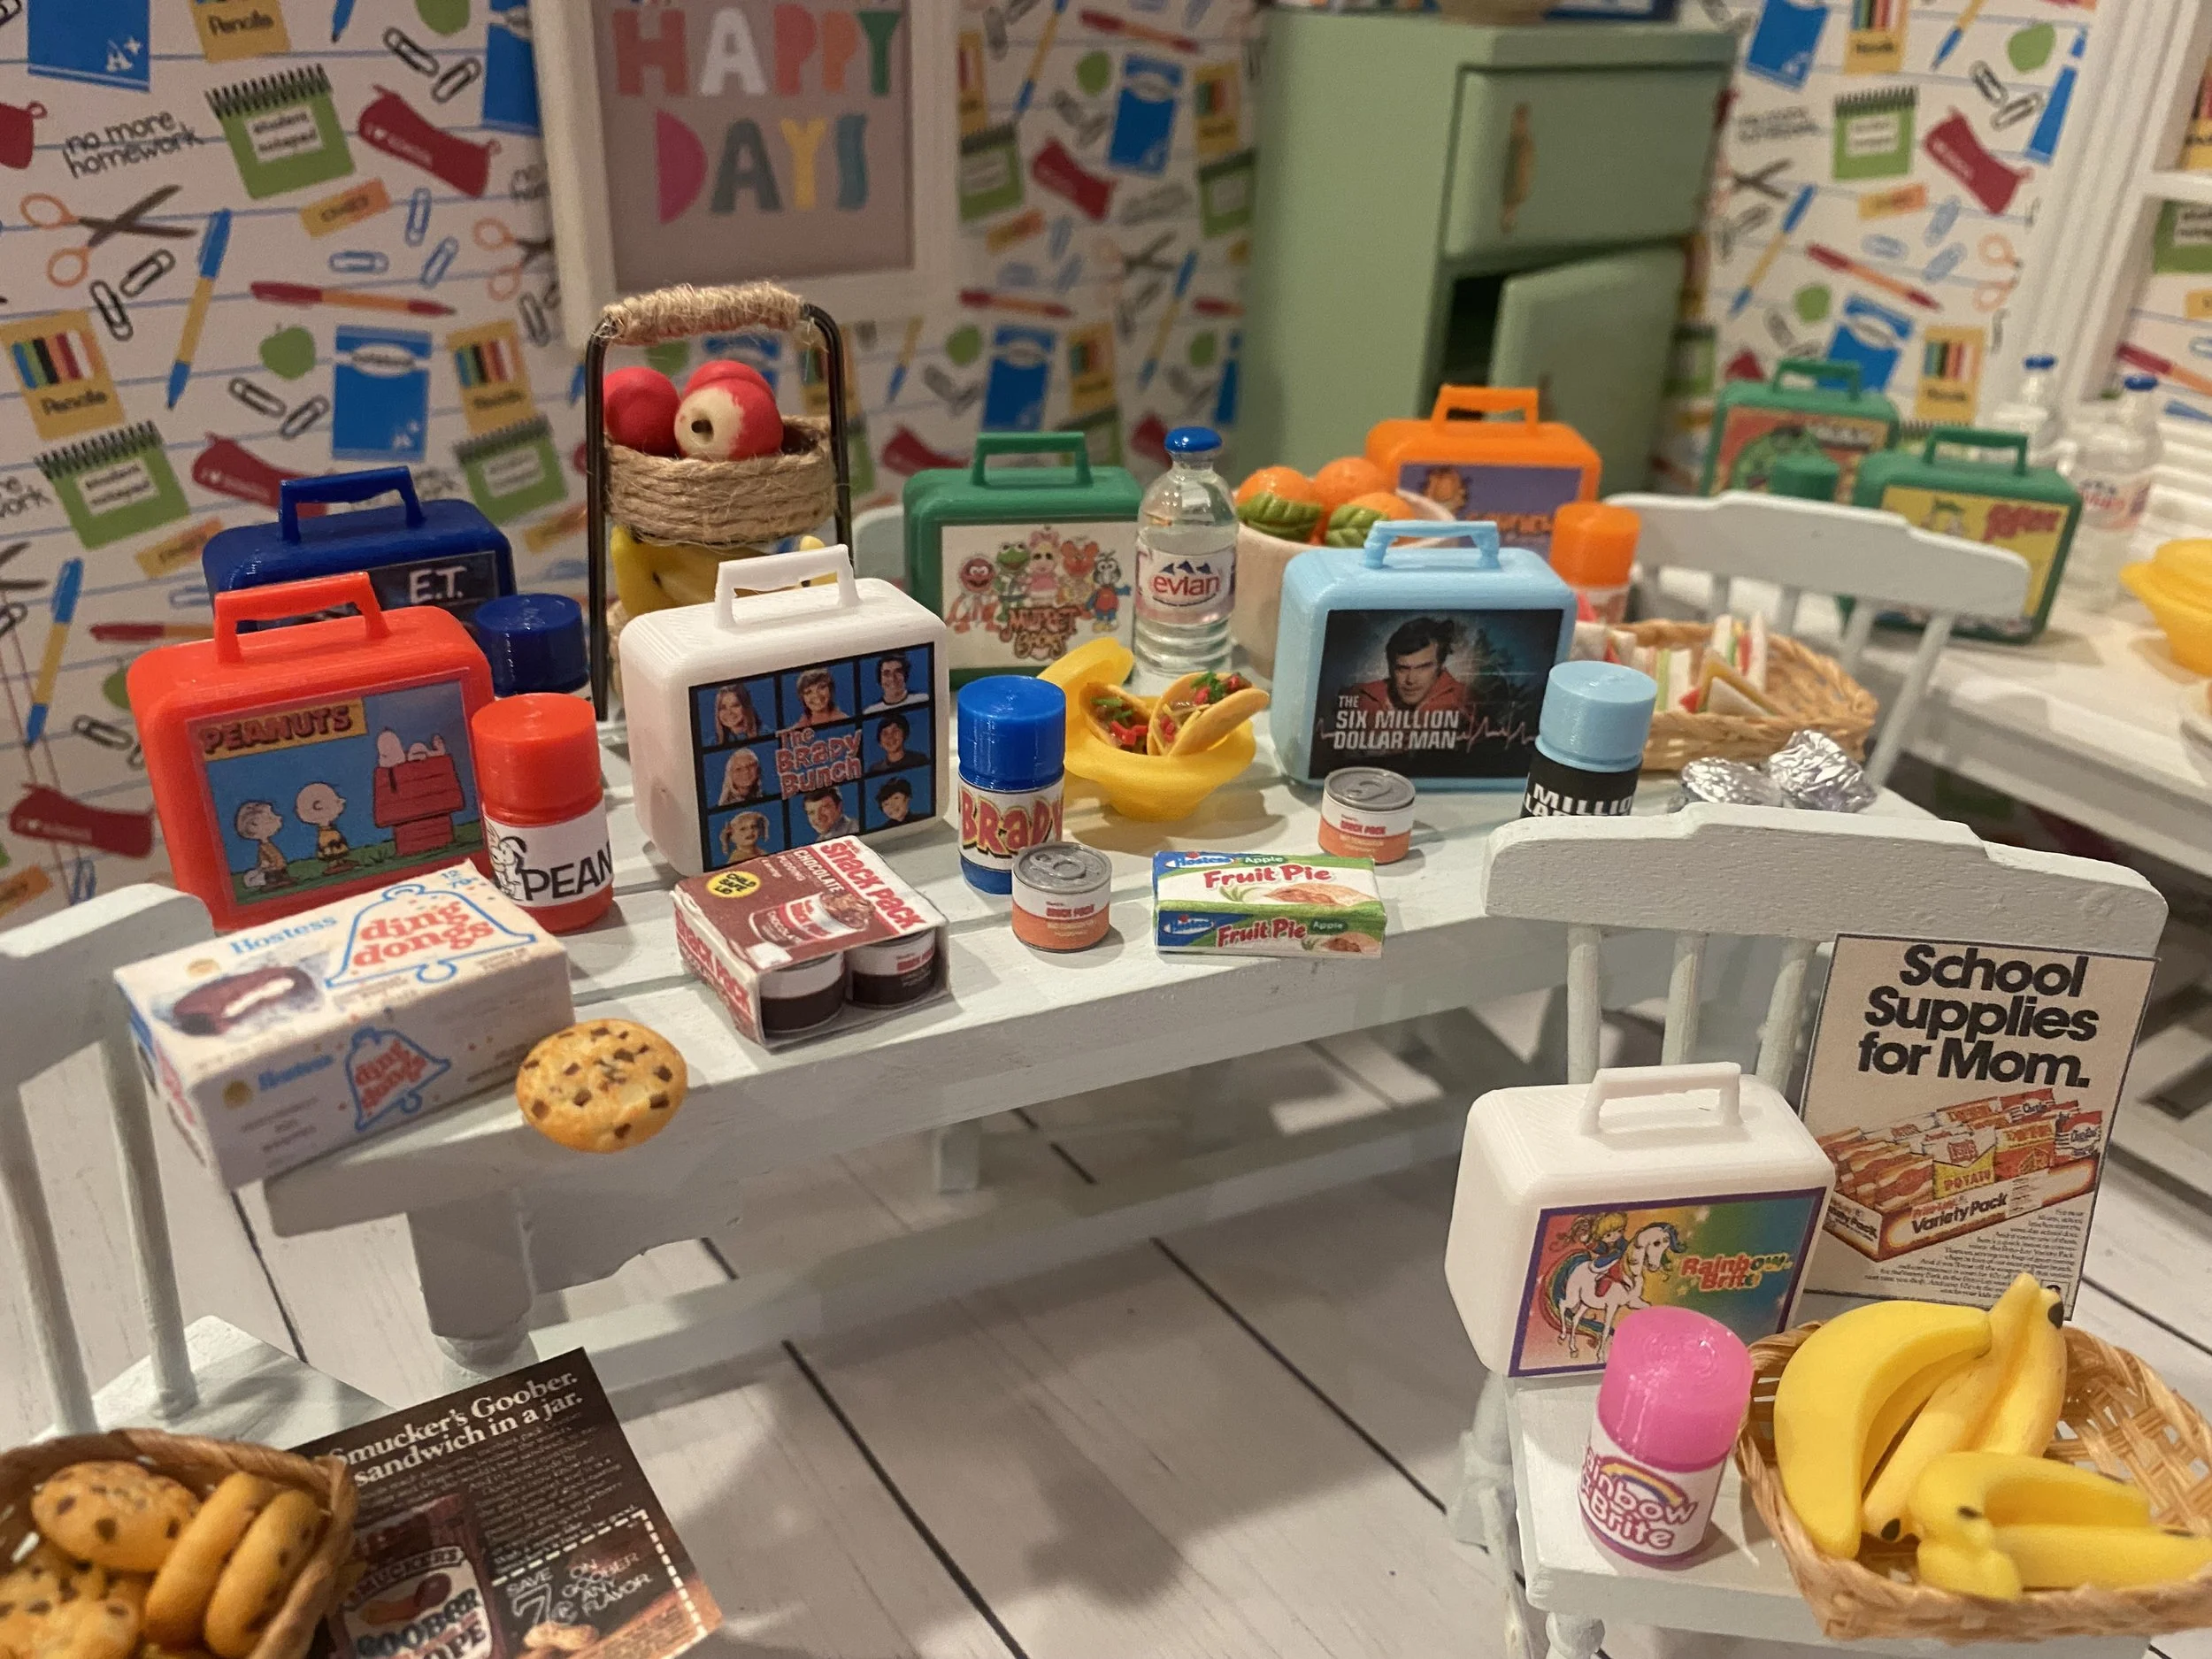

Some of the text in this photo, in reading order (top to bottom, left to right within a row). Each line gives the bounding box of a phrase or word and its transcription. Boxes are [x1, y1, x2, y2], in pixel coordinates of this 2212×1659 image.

[613, 4, 901, 97] HAPPY
[63, 121, 204, 179] homework
[65, 110, 177, 153] no more
[410, 566, 467, 603] E.T.
[1154, 576, 1220, 595] evian
[1335, 710, 1460, 729] SIX MILLION
[1339, 695, 1359, 708] THE
[200, 705, 352, 754] PEANUTS
[1333, 730, 1456, 749] DOLLAR MAN
[790, 849, 846, 893] CHOCOLATE
[1203, 864, 1333, 888] Fruit Pie
[1244, 856, 1284, 864] Apple
[230, 915, 338, 956] Hostess
[360, 900, 471, 943] ding
[1217, 917, 1343, 949] Fruit Pie Apple
[351, 921, 495, 968] dongs
[1899, 943, 2089, 997] School
[1864, 985, 2099, 1043] Supplies
[1857, 1031, 2091, 1088] for Mom.
[1911, 1200, 1970, 1234] Variety
[1969, 1192, 2008, 1217] Pack
[471, 1371, 578, 1418] Goober.
[354, 1390, 583, 1487] sandwich in a jar.
[1590, 1487, 1674, 1549] Brite
[507, 1568, 554, 1598] SAVE
